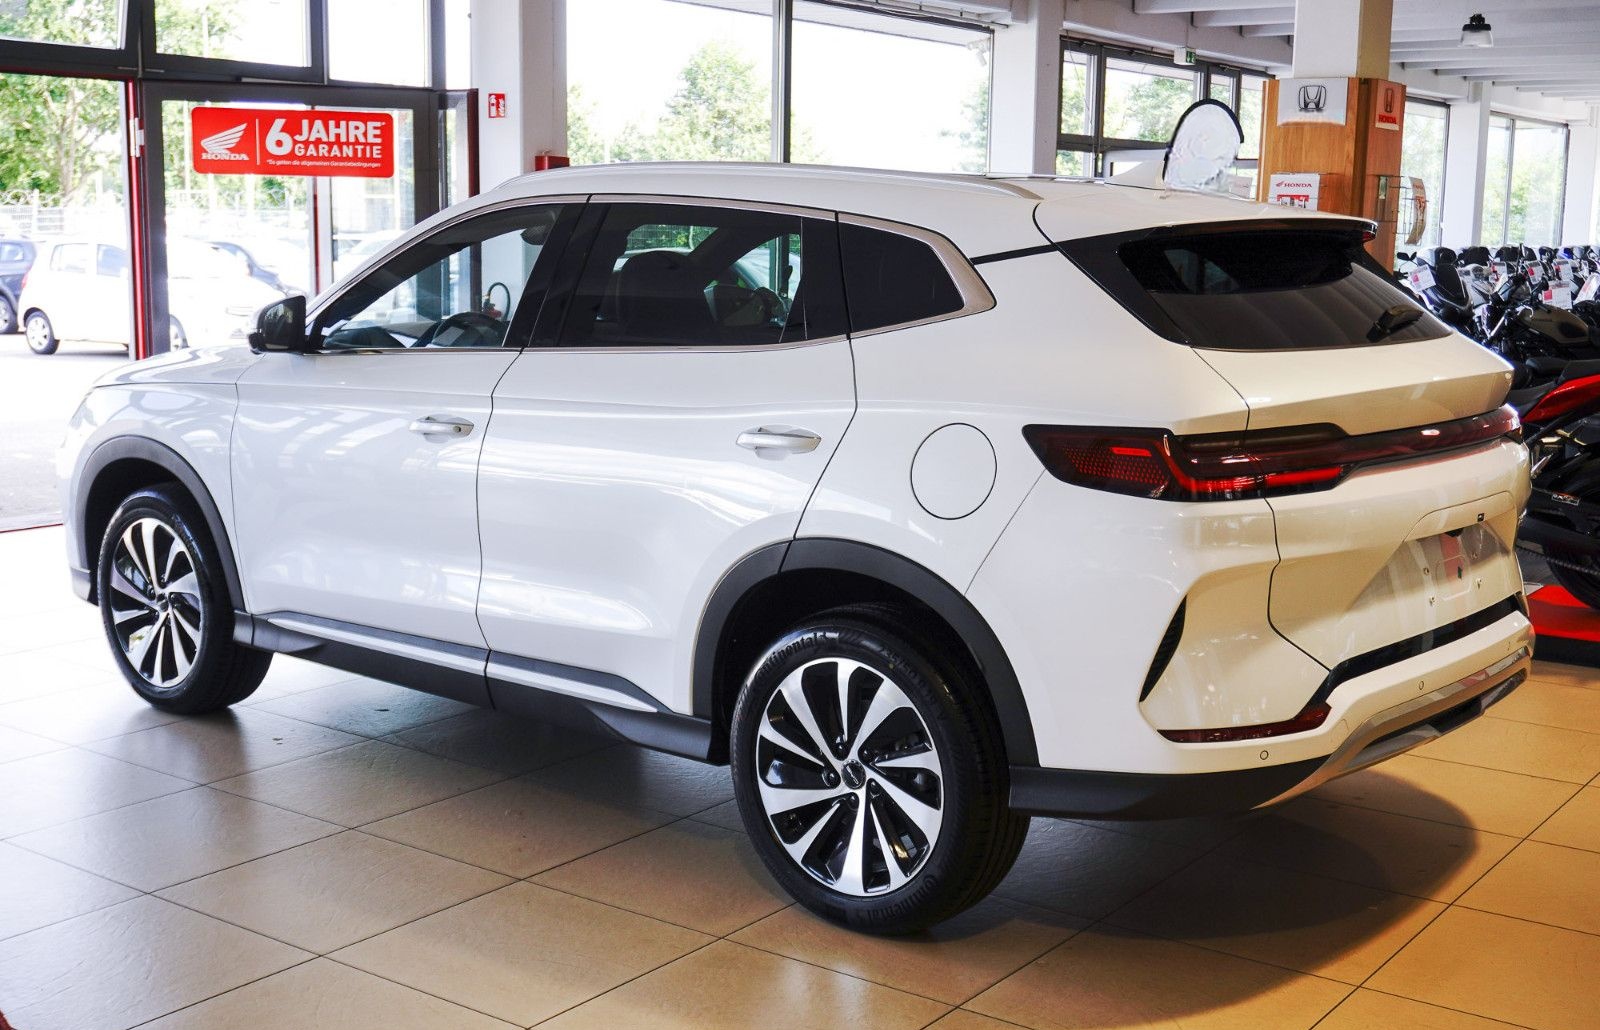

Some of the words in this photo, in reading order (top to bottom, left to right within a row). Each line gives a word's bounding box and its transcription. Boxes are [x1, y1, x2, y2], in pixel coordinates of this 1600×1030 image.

[265, 118, 293, 156] 6
[201, 152, 249, 160] HONDA
[294, 143, 382, 158] GARANTIE
